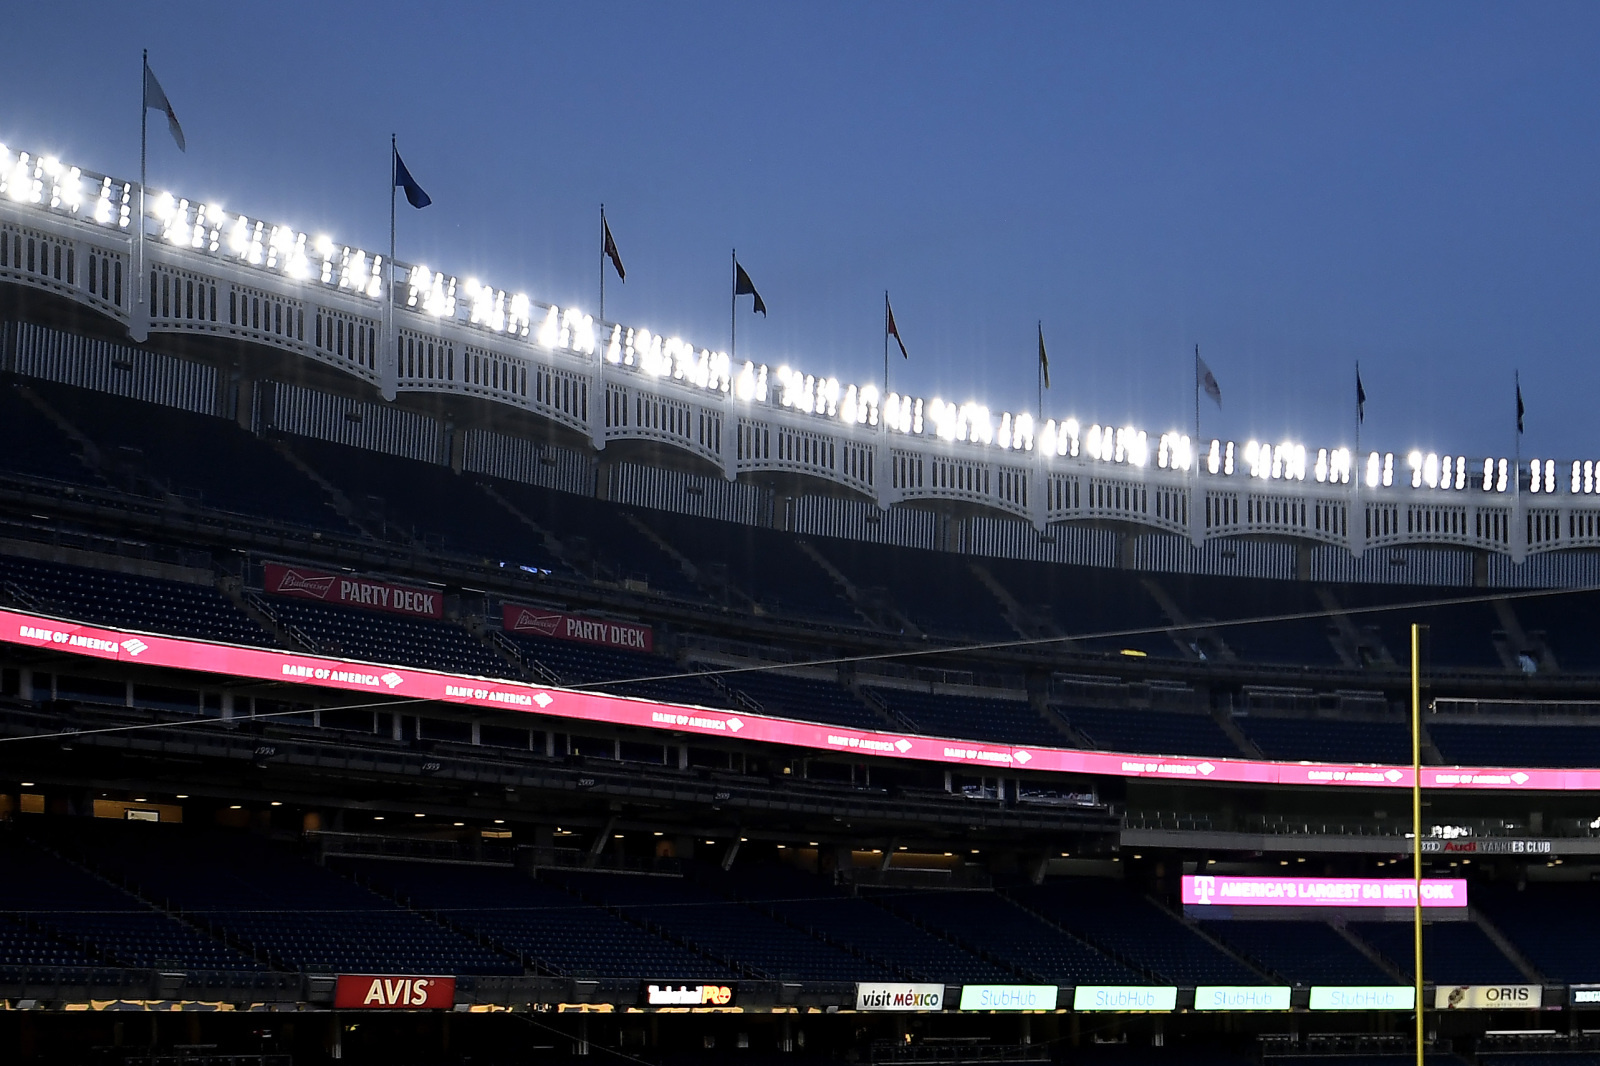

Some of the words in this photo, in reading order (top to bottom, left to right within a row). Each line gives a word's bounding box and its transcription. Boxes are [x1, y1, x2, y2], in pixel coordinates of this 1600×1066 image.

[284, 575, 329, 591] Budweiser
[340, 581, 390, 607] PARTY
[393, 590, 434, 614] DECK
[20, 626, 52, 641] BANK
[52, 630, 69, 643] OF
[69, 635, 119, 653] AMERICA
[566, 618, 607, 641] PARTY
[611, 625, 645, 648] DECK
[282, 664, 313, 678] BANK
[315, 669, 331, 679] OF
[330, 671, 380, 686] AMERICA
[446, 685, 474, 698] BANK
[474, 689, 489, 699] OF
[488, 691, 532, 706] AMERICA
[652, 712, 676, 725] BANK
[676, 714, 688, 725] OF
[688, 716, 726, 731] AMERICA
[828, 735, 849, 745] BANK
[849, 737, 860, 748] OF
[859, 738, 894, 751] AMERICA
[1443, 835, 1476, 851] Audi
[1480, 835, 1525, 852] YANKEES
[1527, 834, 1551, 852] CLUB
[1220, 882, 1297, 898] AMERICA'S
[1299, 883, 1361, 899] LARGEST
[363, 979, 429, 1005] AVIS
[863, 990, 891, 1007] visit
[980, 989, 1036, 1006] StubHub
[1096, 990, 1155, 1006] StubHub
[1214, 991, 1272, 1005] StubHub
[1330, 991, 1394, 1005] StubHub
[1486, 988, 1529, 1001] ORIS
